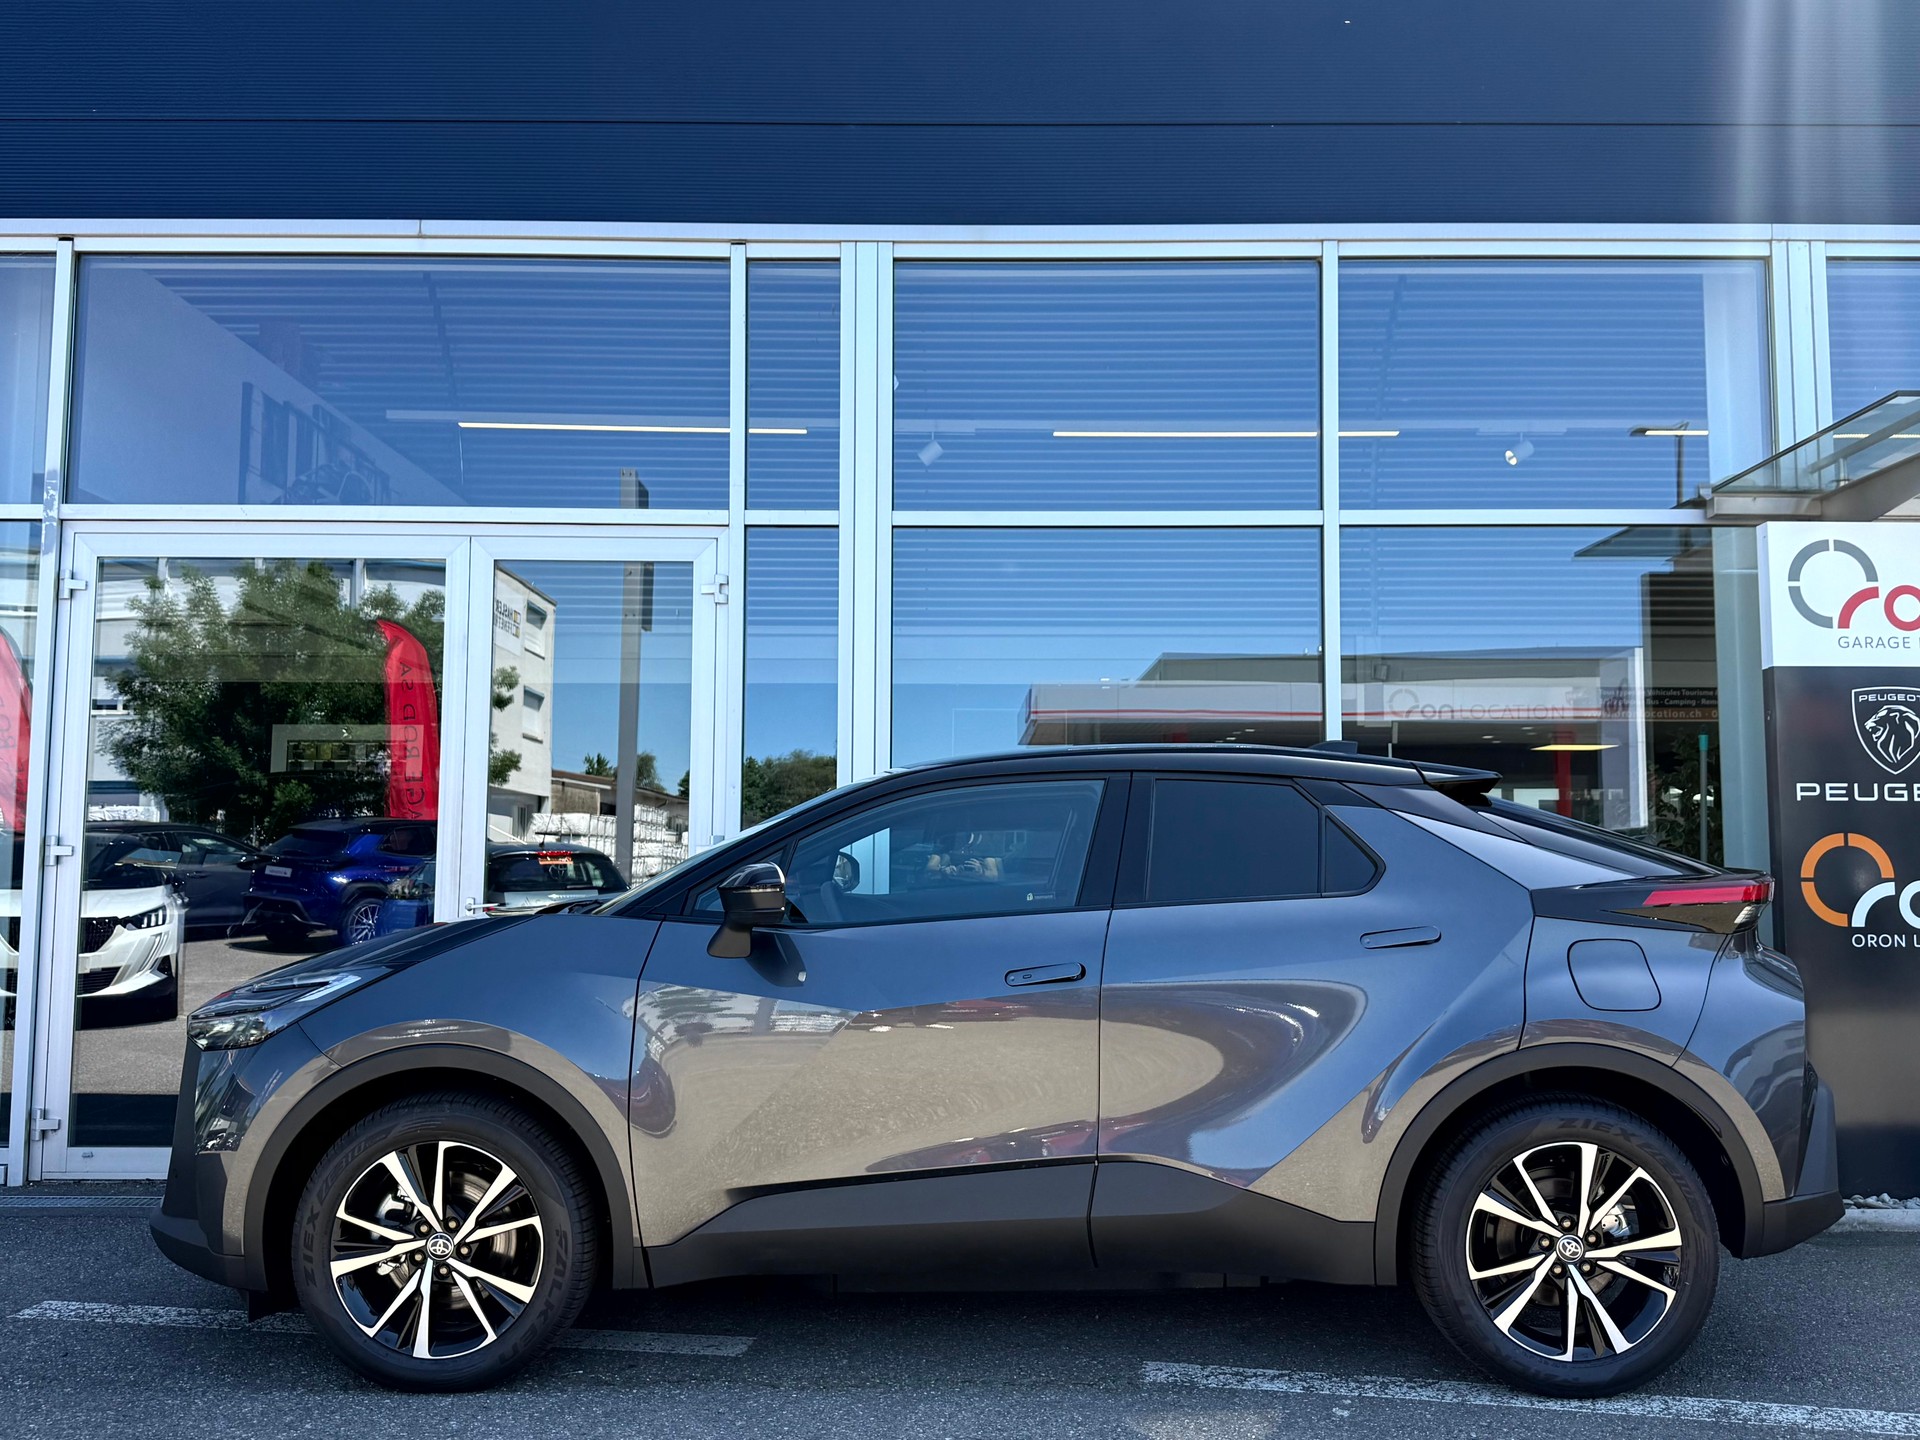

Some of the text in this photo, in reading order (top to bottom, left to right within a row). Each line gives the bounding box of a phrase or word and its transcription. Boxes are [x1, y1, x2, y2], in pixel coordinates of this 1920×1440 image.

[1838, 636, 1911, 649] GARAGE
[1682, 688, 1713, 696] Tourisme
[1664, 698, 1695, 706] Camping
[1459, 703, 1565, 720] LOCATION
[1796, 783, 1920, 801] PEUG
[1852, 933, 1906, 948] ORON
[1556, 1117, 1640, 1144] ZIEX
[303, 1205, 320, 1288] ZIEX
